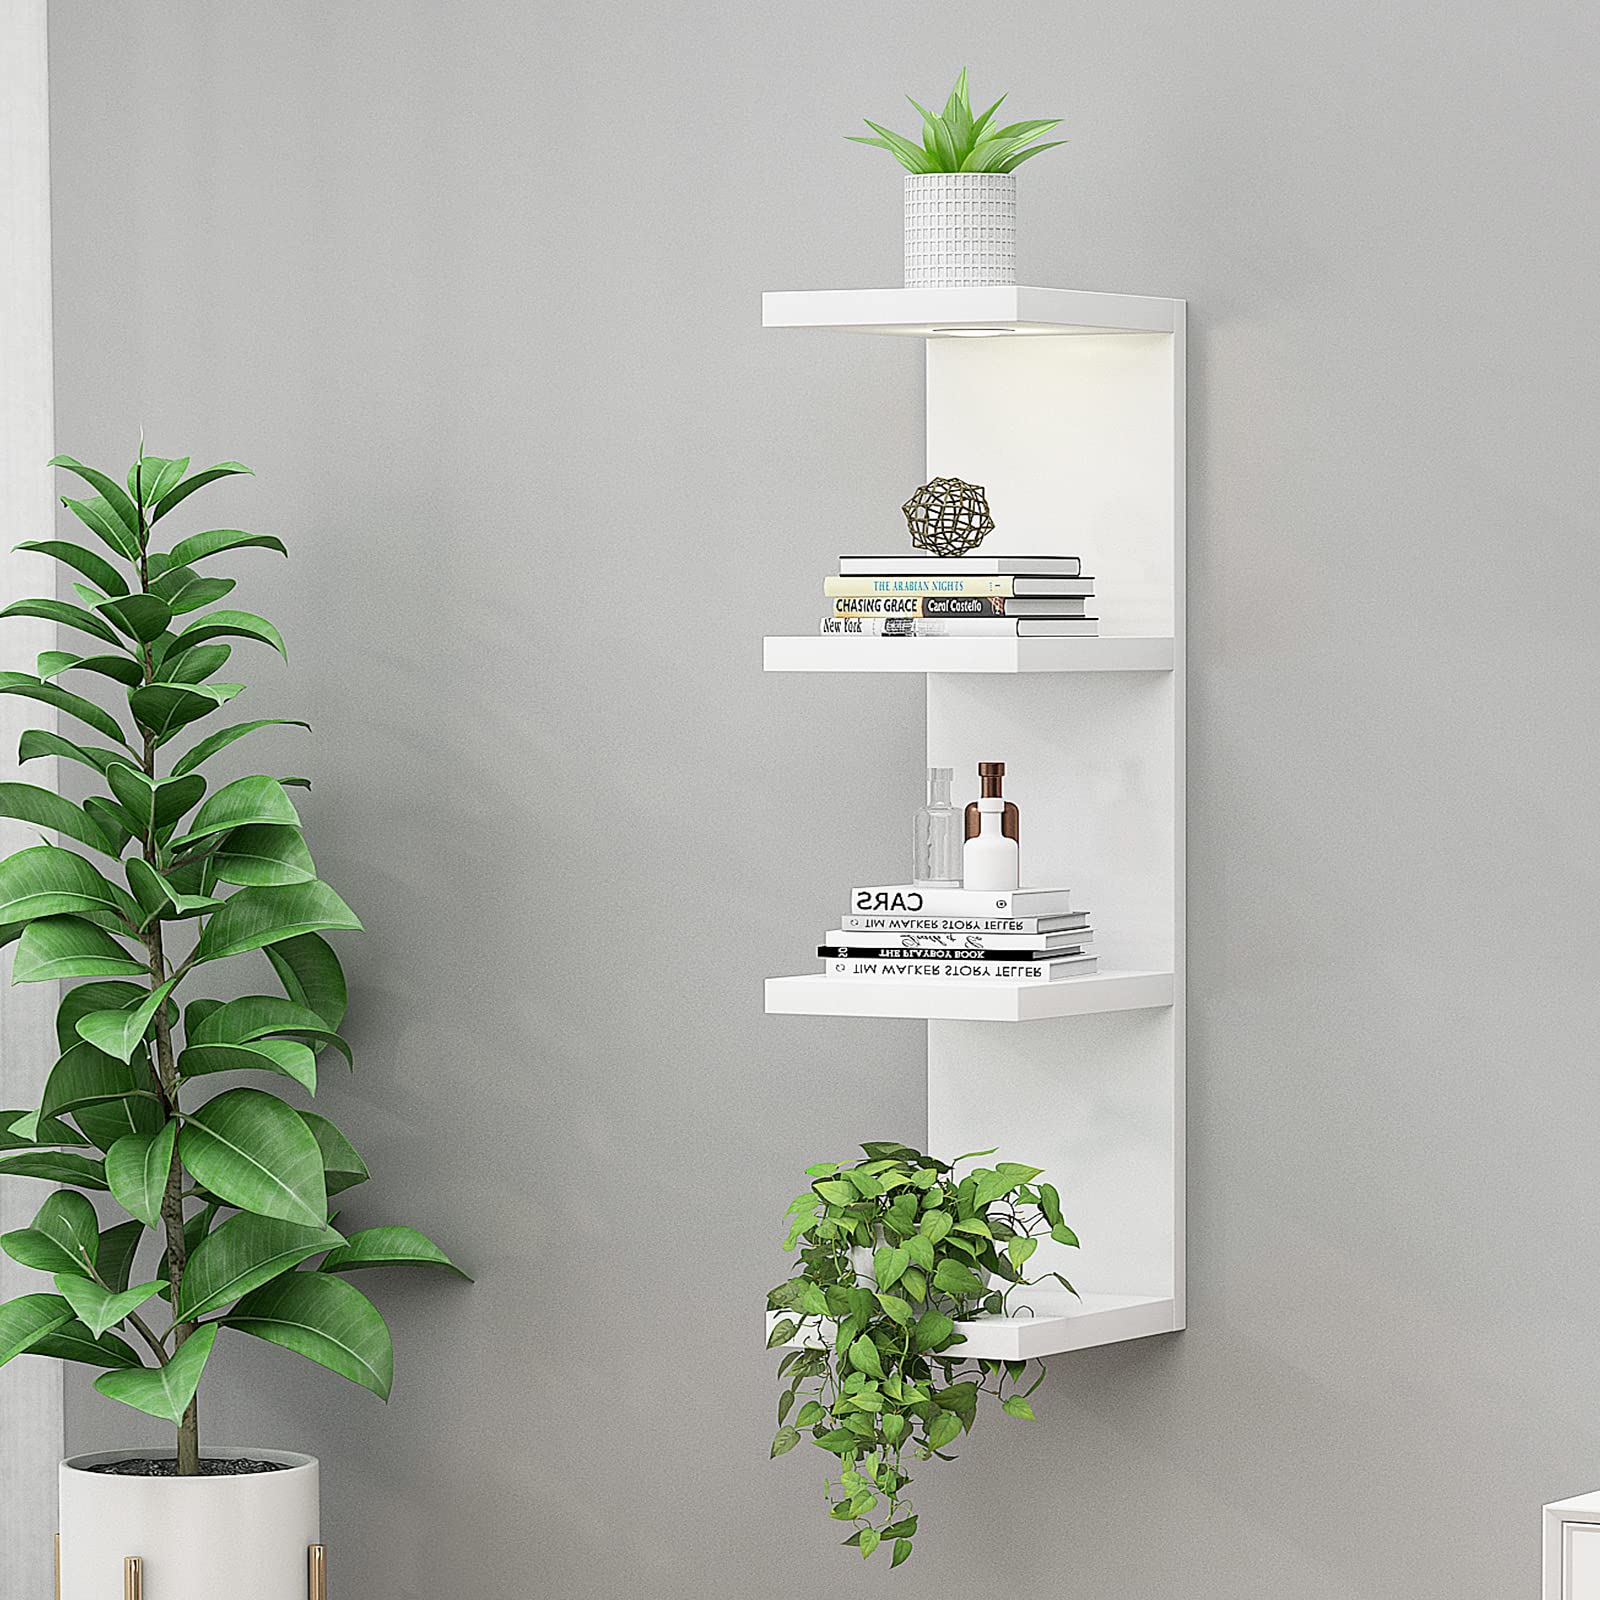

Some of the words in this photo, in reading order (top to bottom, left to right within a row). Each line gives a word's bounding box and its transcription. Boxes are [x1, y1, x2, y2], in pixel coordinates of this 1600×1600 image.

[873, 581, 890, 592] THE
[893, 581, 929, 592] ARABIAN
[932, 580, 964, 592] NIGHTS
[835, 599, 881, 612] CHASING
[883, 599, 918, 612] GRACE
[927, 600, 948, 612] Carol
[823, 618, 841, 633] New
[844, 618, 862, 633] York
